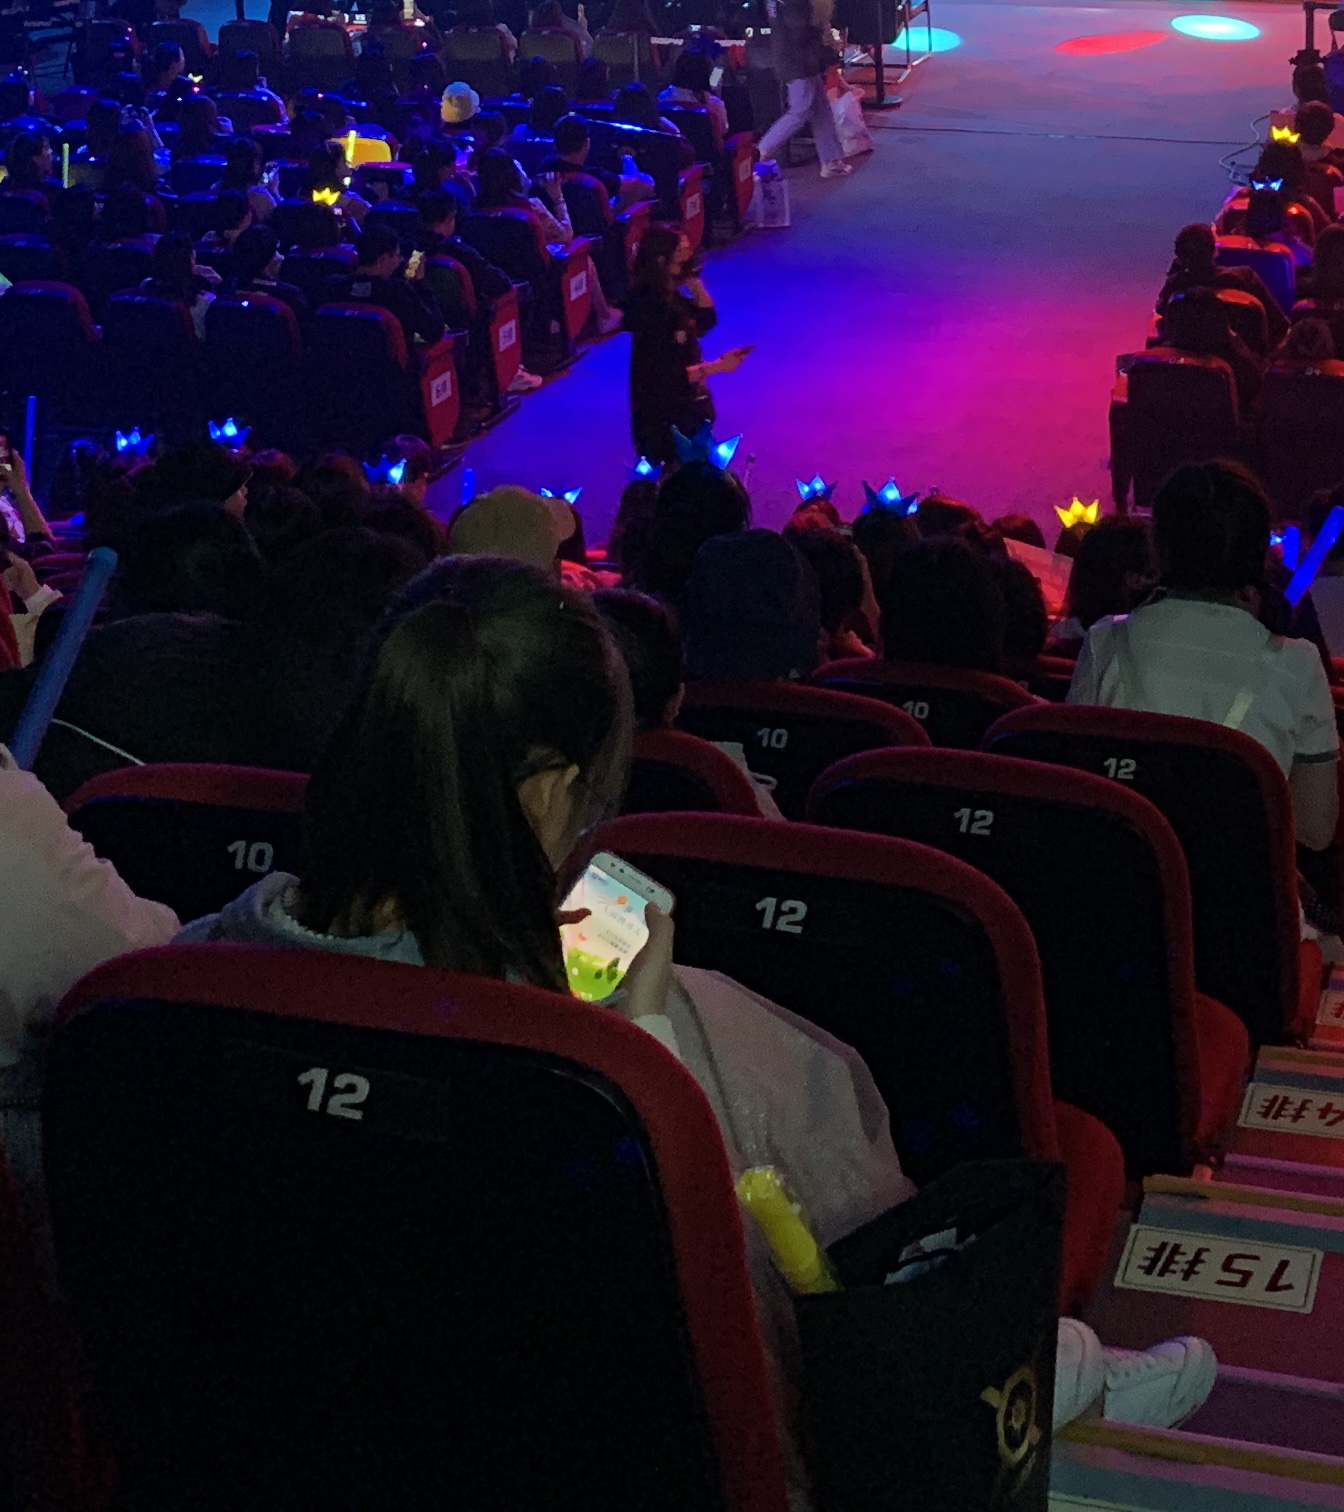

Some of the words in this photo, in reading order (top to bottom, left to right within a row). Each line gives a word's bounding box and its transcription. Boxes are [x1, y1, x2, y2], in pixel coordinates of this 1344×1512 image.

[902, 700, 930, 720] 10
[755, 726, 789, 750] 10
[1103, 755, 1138, 780] 12
[952, 806, 996, 837] 12
[226, 839, 275, 873] 10
[754, 895, 809, 936] 12
[297, 1066, 371, 1121] 12
[1138, 1240, 1296, 1297] 15排
